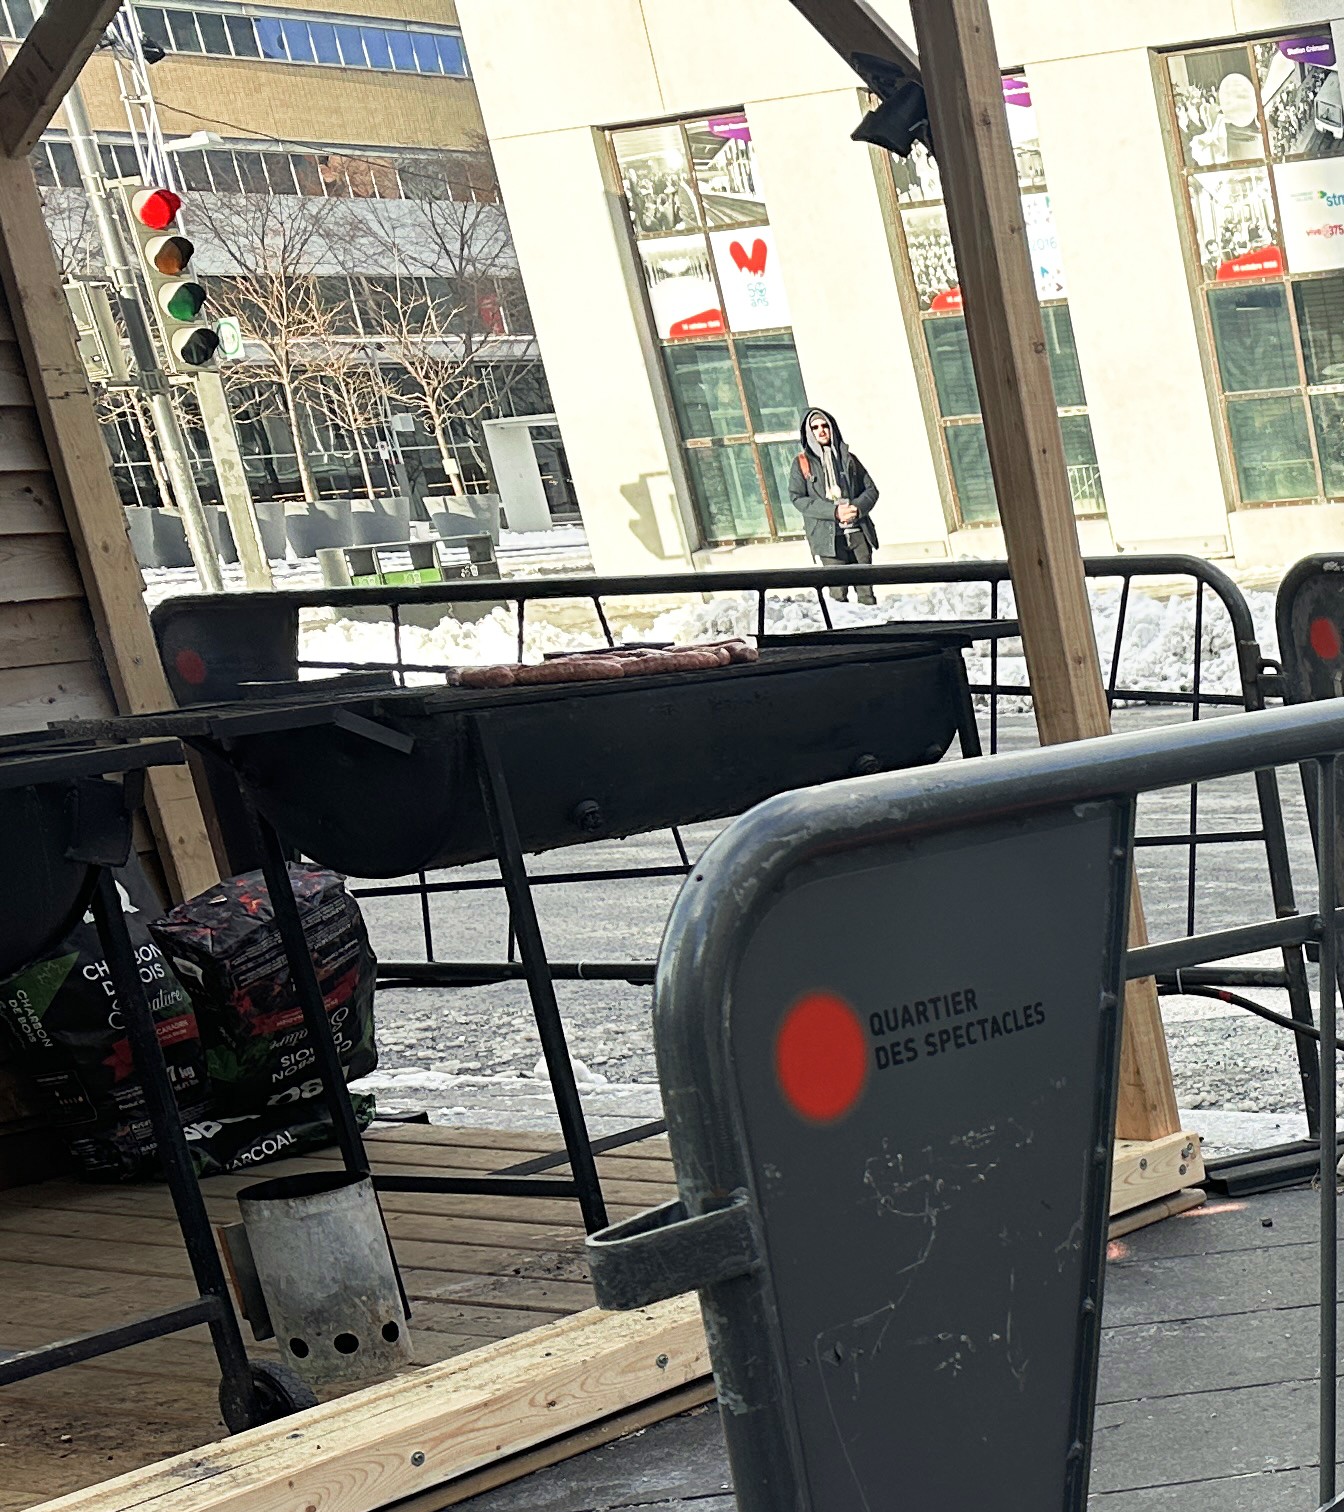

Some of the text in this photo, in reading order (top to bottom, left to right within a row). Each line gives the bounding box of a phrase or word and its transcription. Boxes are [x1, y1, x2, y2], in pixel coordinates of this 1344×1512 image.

[16, 989, 53, 1048] CHARBON
[17, 1016, 37, 1043] BOIS
[869, 988, 979, 1037] QUARTIER
[874, 1001, 1046, 1070] DES SPECTACLES
